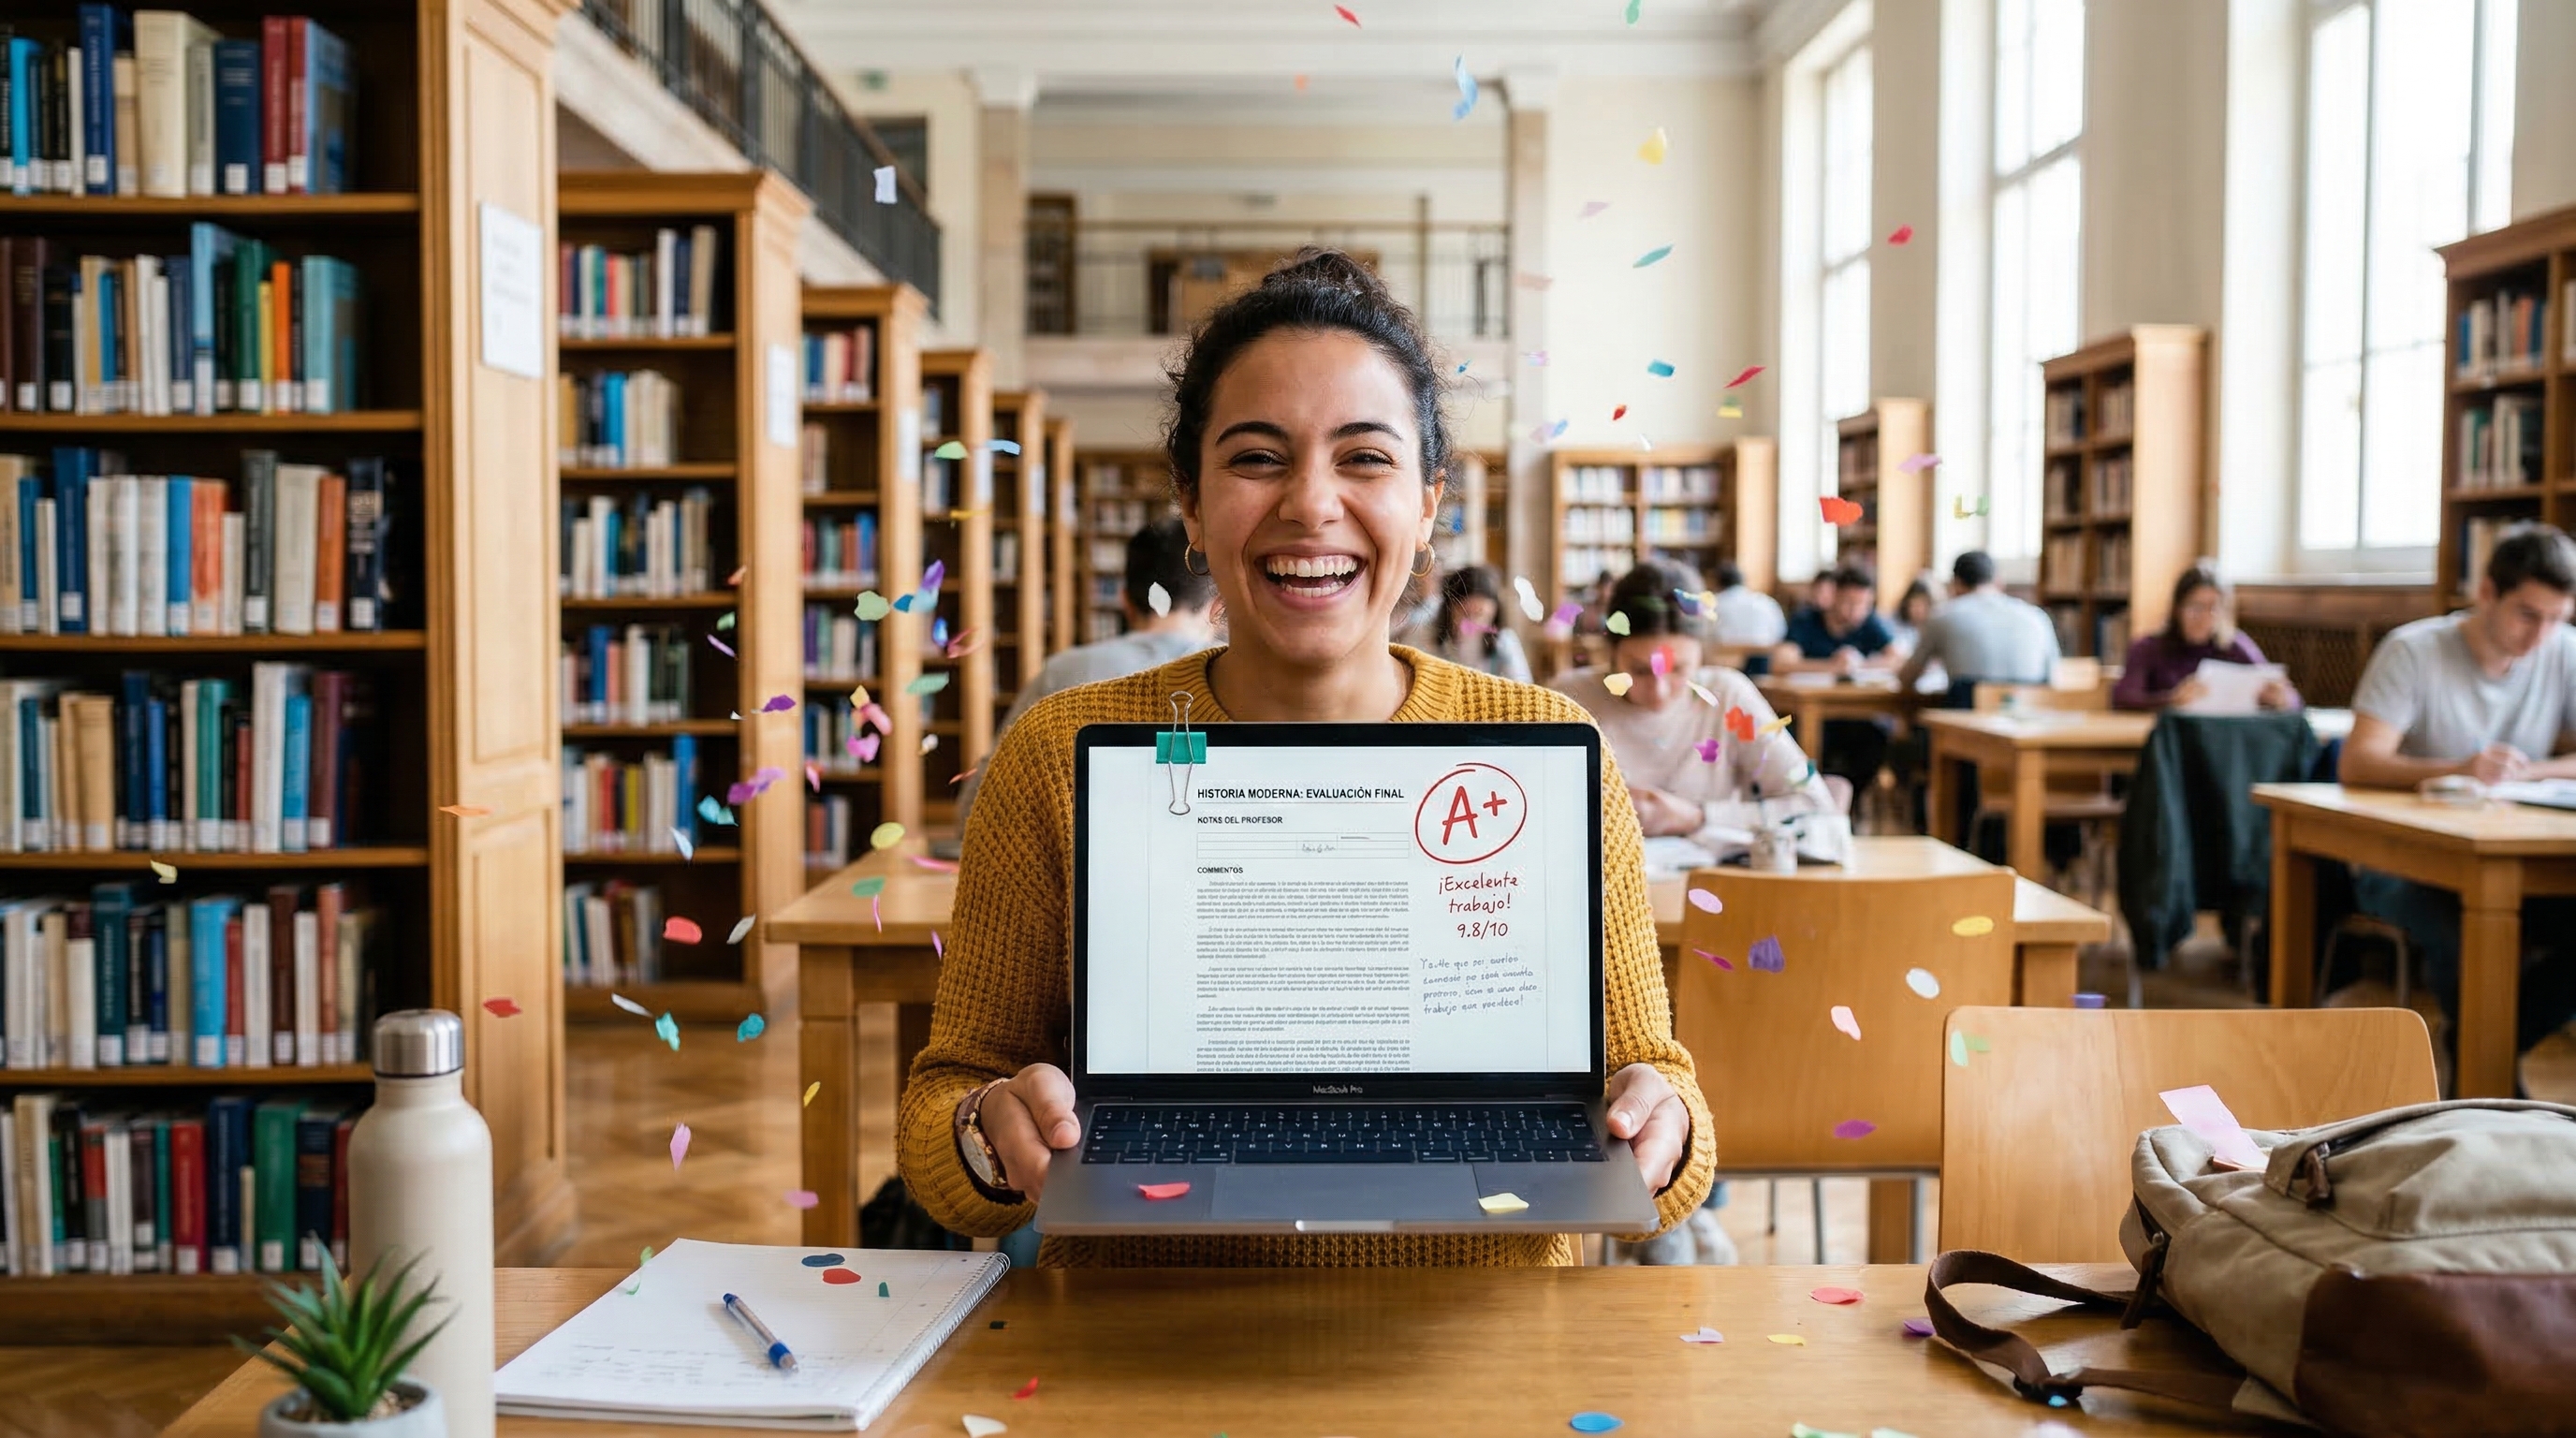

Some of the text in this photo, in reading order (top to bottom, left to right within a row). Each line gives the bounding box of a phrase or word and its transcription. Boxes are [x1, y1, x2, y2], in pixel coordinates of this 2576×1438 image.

[1197, 785, 1405, 800] HISTORIA MODERNA: EVALUACIÓN FINAL
[1241, 815, 1283, 825] PROFESOR
[1442, 785, 1508, 846] A+
[1439, 872, 1518, 895] ¡Excelente
[1448, 893, 1511, 914] trabajo!
[1456, 921, 1508, 940] 9.8/10
[1350, 1084, 1364, 1093] Pro
